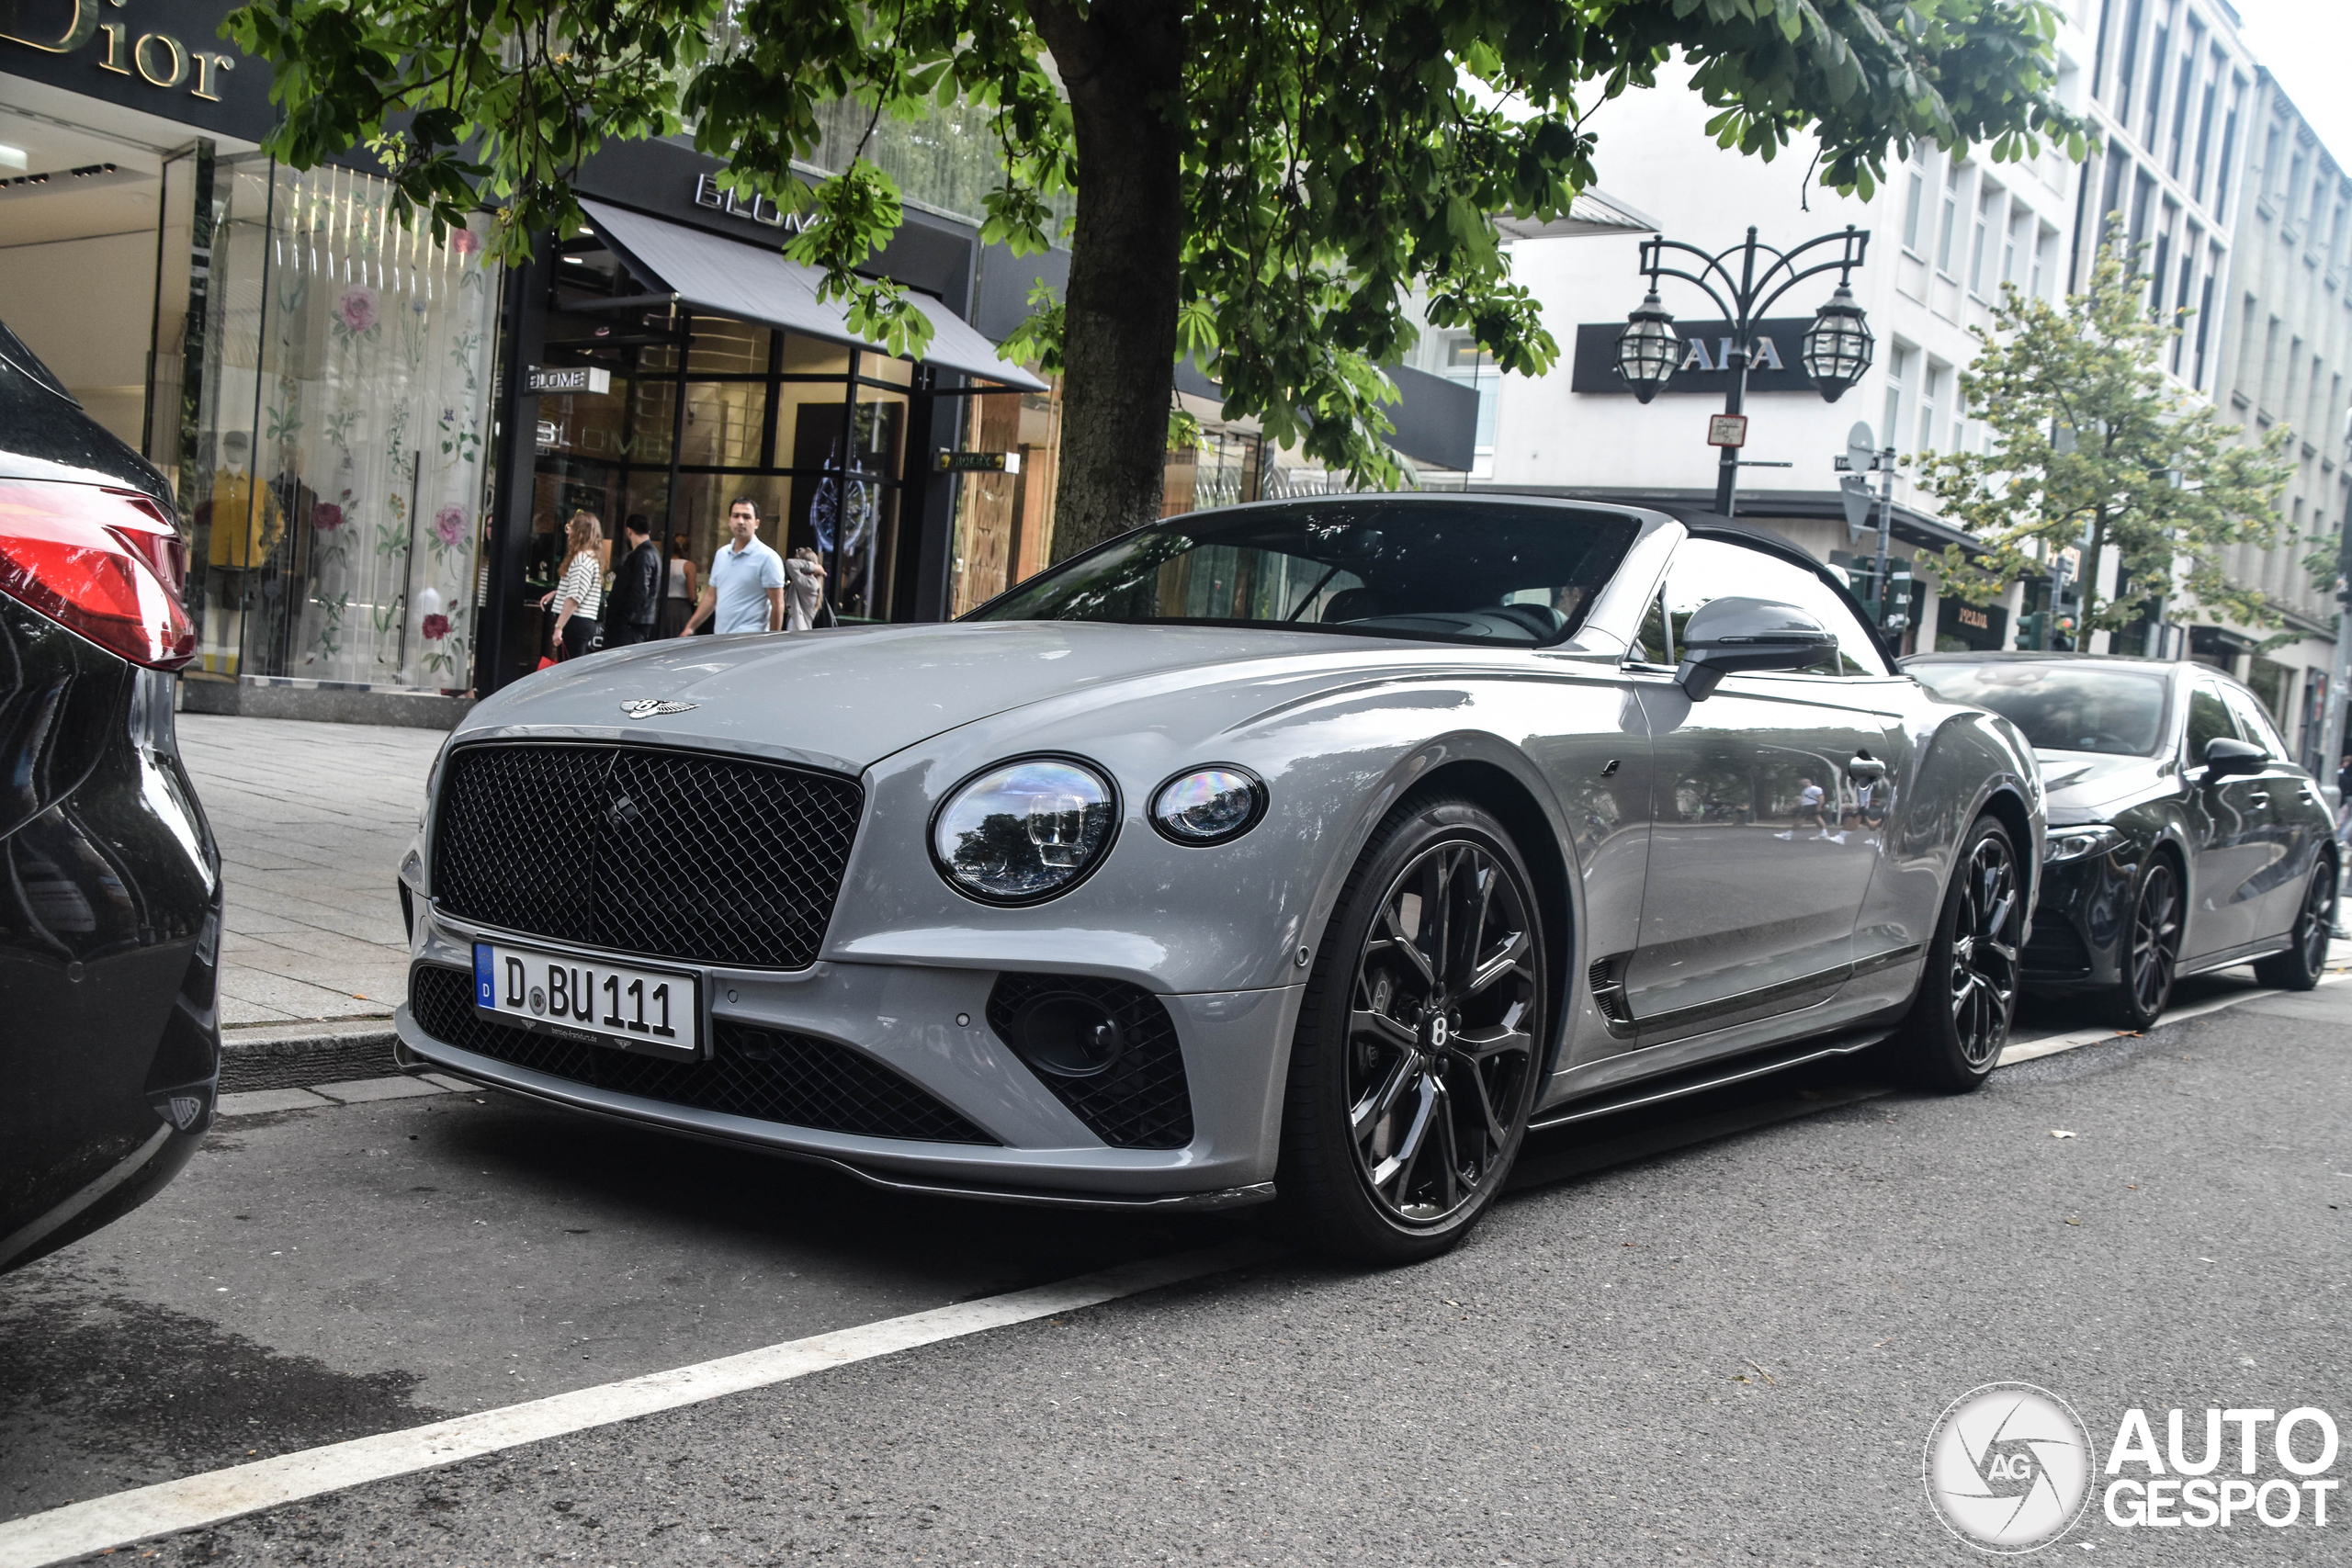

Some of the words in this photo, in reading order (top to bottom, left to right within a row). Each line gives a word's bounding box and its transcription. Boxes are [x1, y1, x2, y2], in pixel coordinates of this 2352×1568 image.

[695, 173, 831, 233] BLOM
[530, 371, 585, 389] BLOME
[482, 983, 490, 998] D
[505, 955, 526, 1008] D
[1431, 1017, 1447, 1046] B
